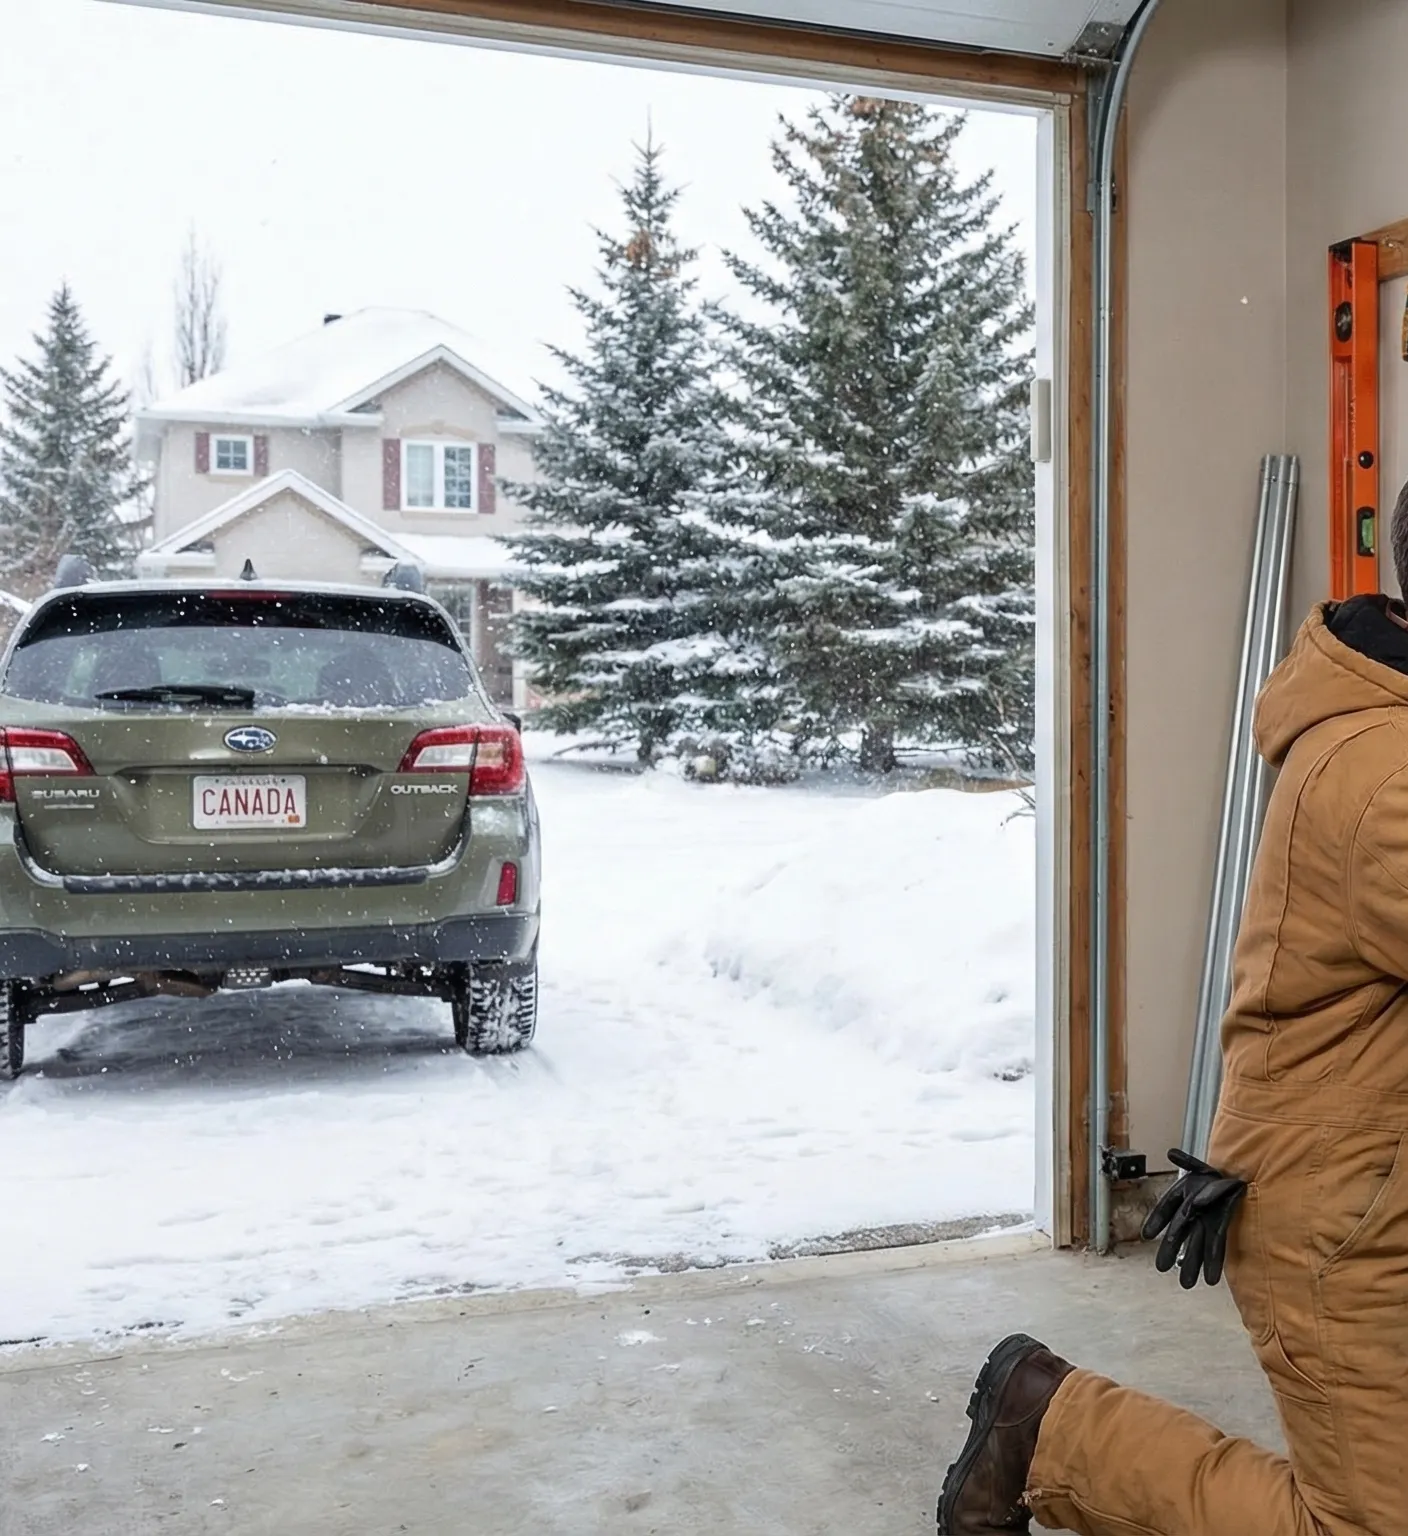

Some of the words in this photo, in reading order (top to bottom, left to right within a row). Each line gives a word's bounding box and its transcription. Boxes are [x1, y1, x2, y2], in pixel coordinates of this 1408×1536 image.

[31, 788, 100, 799] SUBARU
[390, 783, 459, 795] OUTBACK
[202, 787, 297, 817] CANADA
